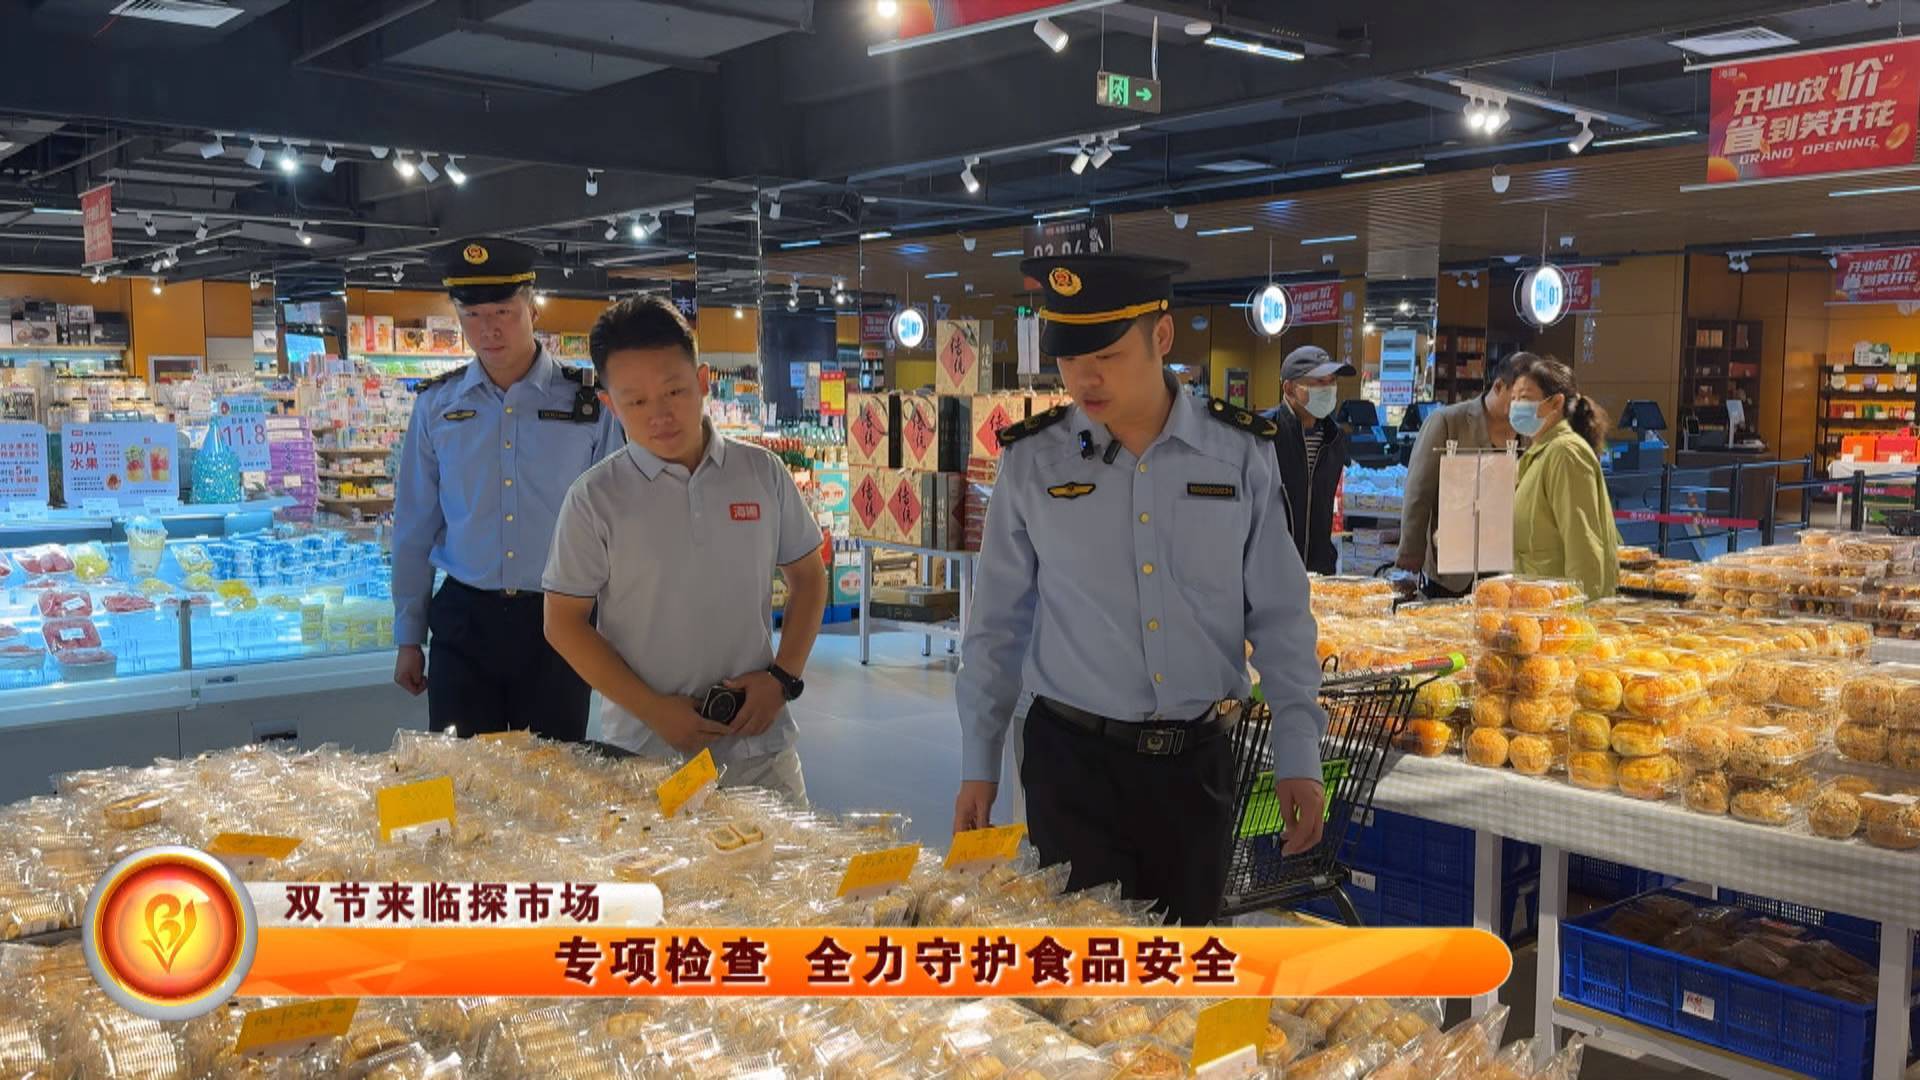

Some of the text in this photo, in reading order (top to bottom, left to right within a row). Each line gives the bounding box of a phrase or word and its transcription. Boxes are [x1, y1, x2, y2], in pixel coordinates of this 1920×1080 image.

[1734, 54, 1894, 116] 开业放"价"
[1724, 100, 1897, 155] 省到笑开花
[1739, 135, 1877, 165] GRAND OPENING
[70, 441, 98, 455] 切片
[222, 424, 265, 447] 11.8
[70, 457, 98, 471] 水果
